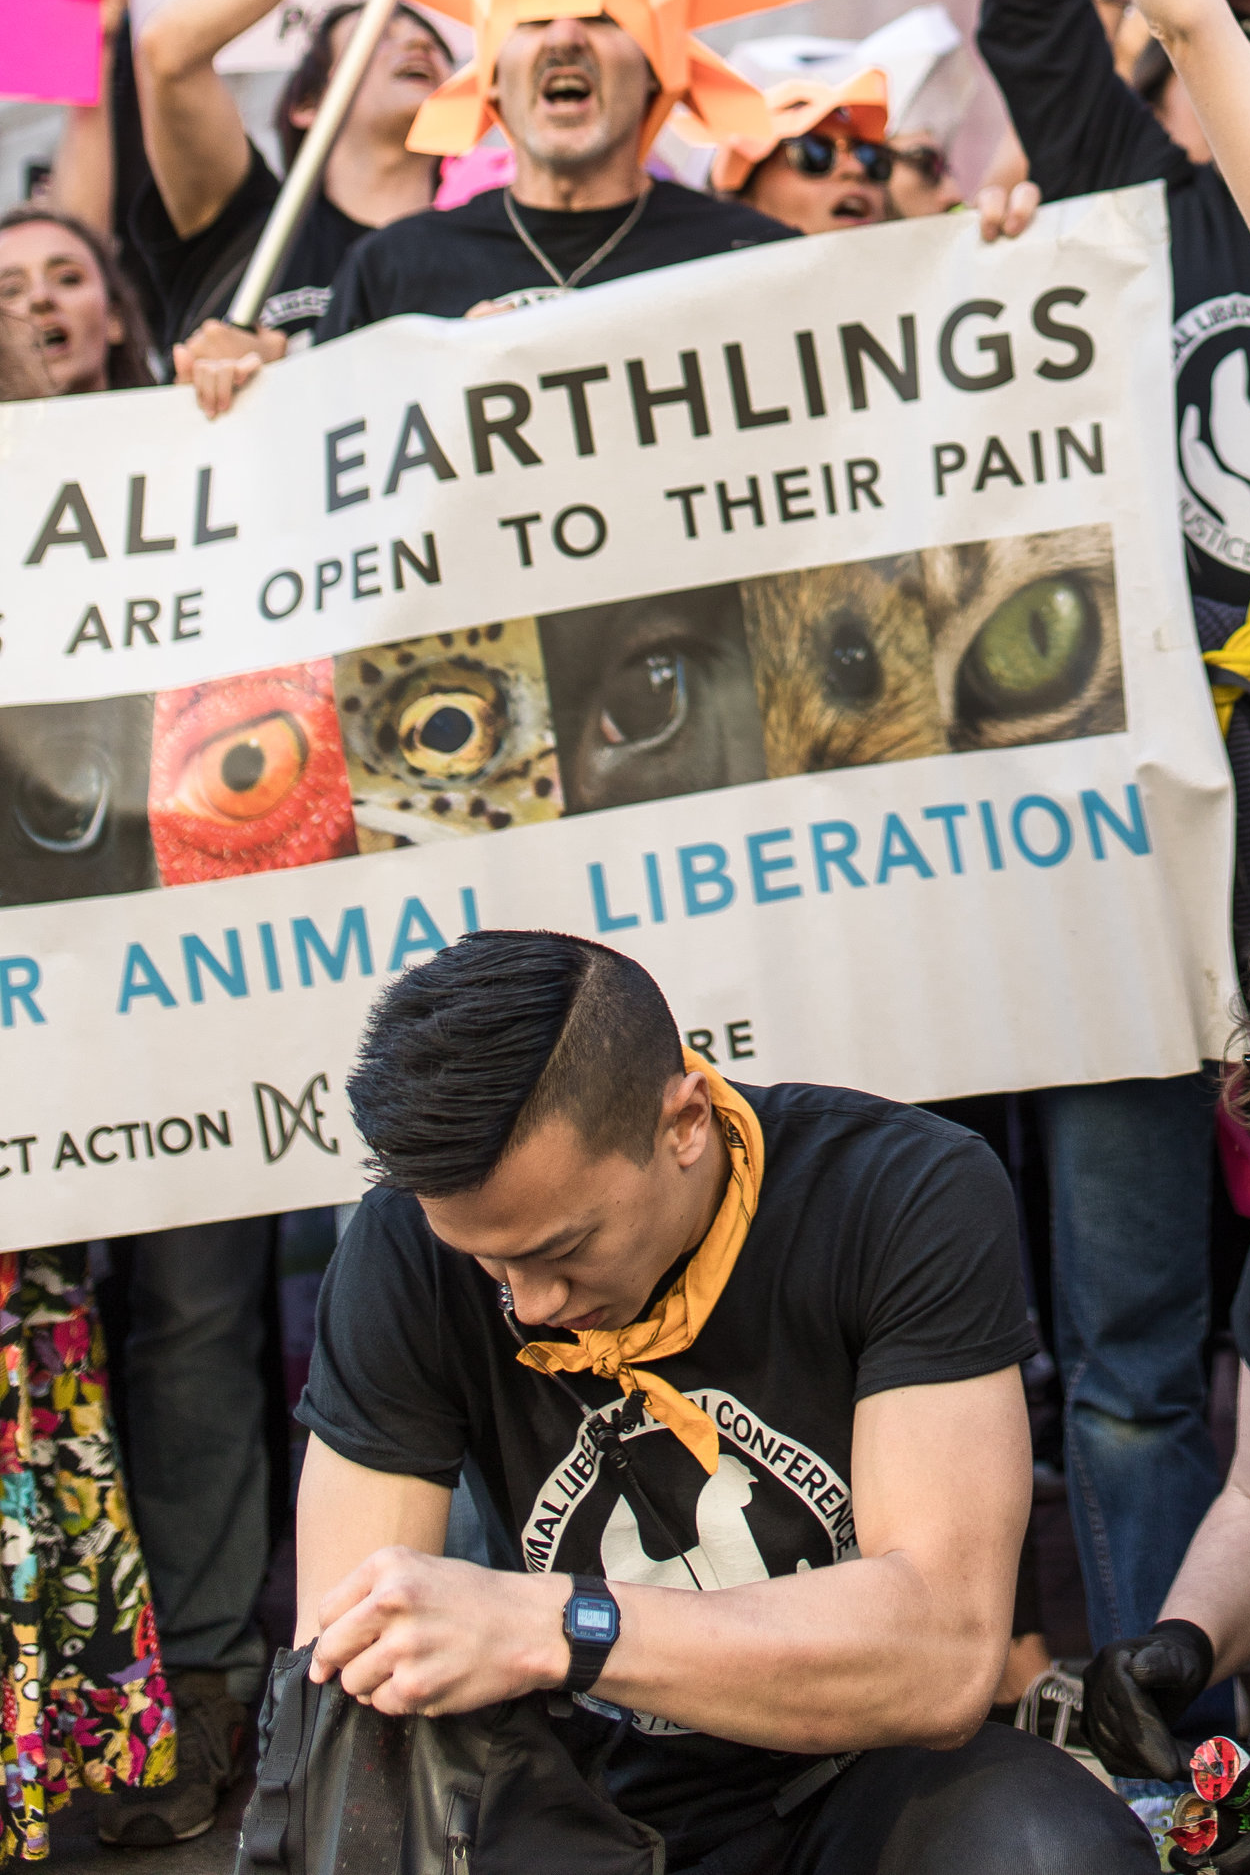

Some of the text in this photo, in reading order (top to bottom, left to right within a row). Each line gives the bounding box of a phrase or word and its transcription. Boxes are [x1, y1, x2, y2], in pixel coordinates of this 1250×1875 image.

[24, 286, 1095, 566] ALL EARTHLINGS
[66, 591, 203, 654] ARE
[259, 532, 442, 622] OPEN
[500, 503, 609, 568] TO
[665, 457, 884, 540] THEIR
[932, 422, 1107, 497] PAIN
[587, 783, 1153, 934] LIBERATION
[54, 1110, 233, 1169] ACTION
[716, 1400, 857, 1561] CONFERENCE
